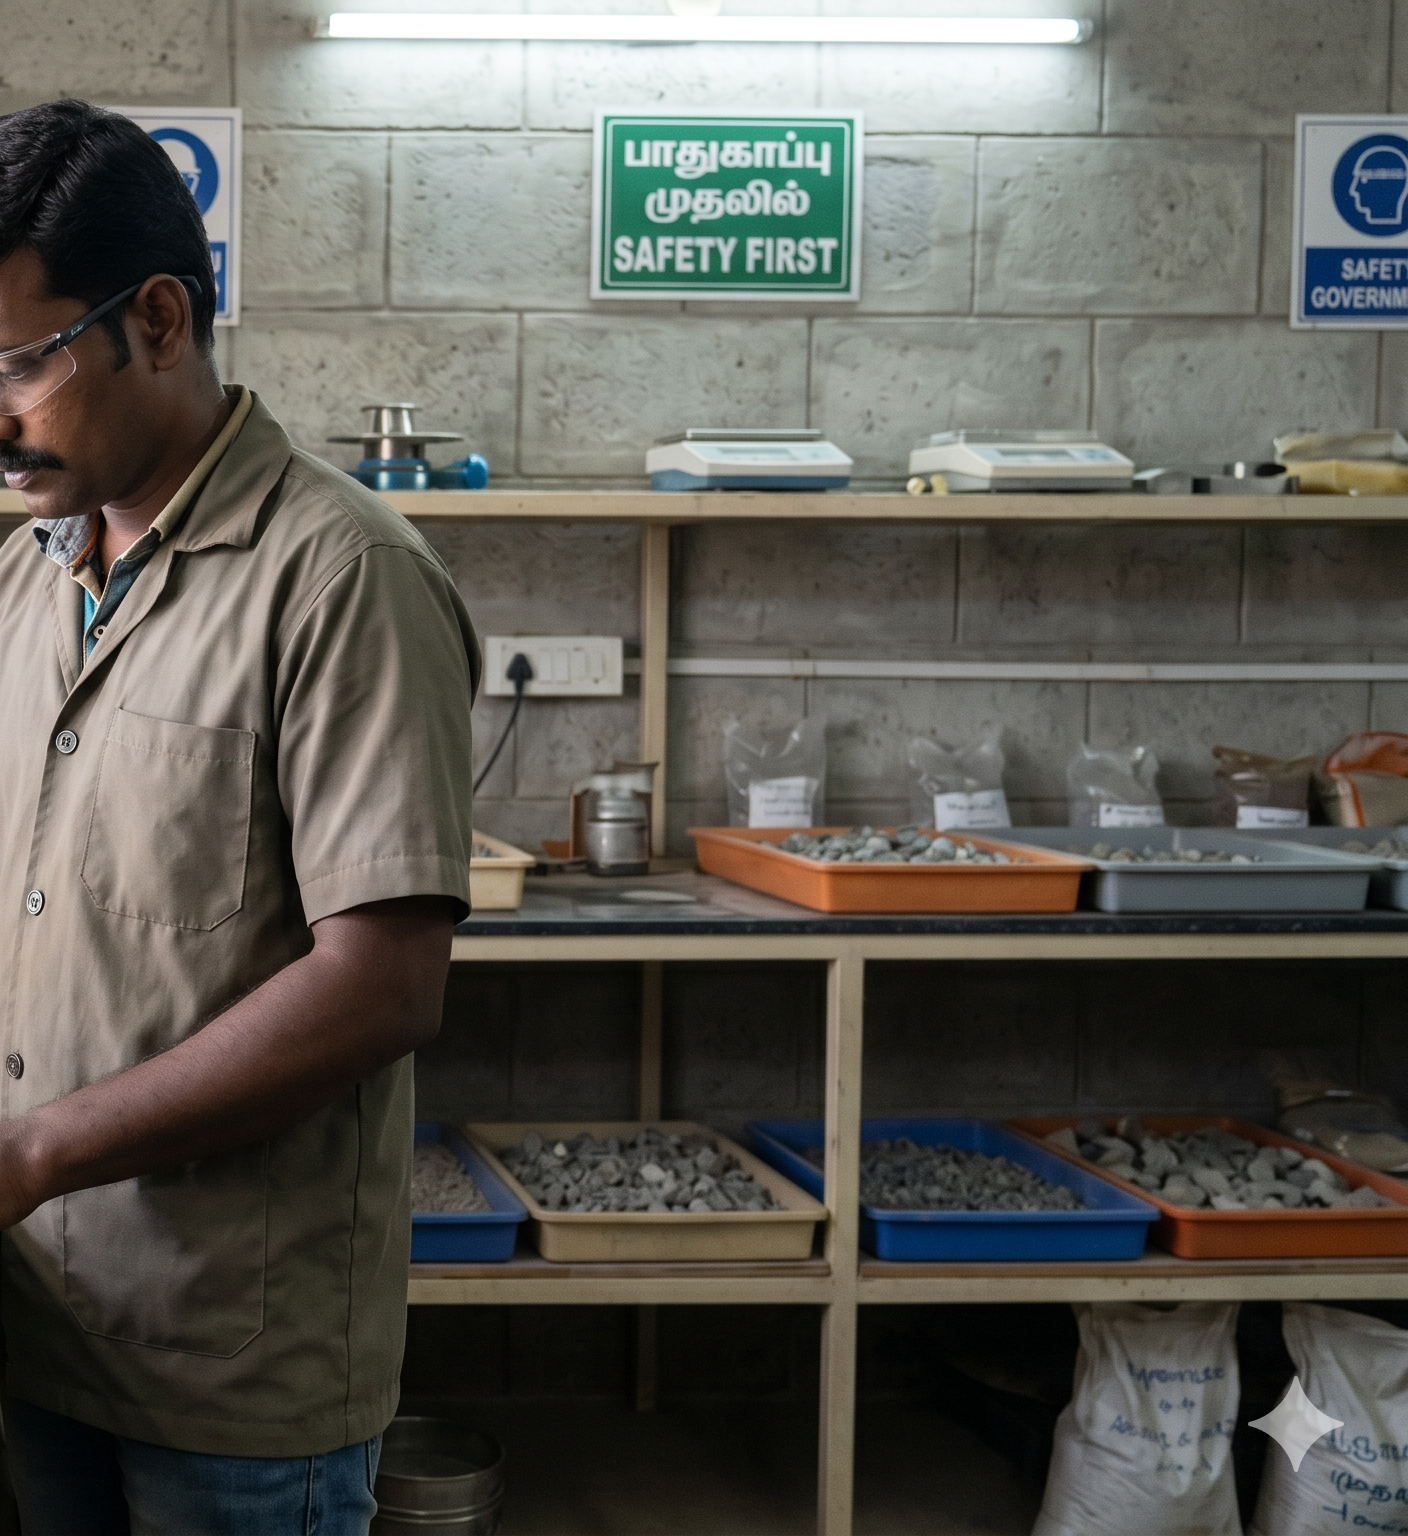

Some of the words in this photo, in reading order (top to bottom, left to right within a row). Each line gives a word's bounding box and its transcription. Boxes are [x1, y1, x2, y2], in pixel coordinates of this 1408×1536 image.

[624, 130, 832, 179] பாதுகாப்பு
[645, 179, 811, 224] முதலில்
[613, 235, 738, 273] SAFETY
[745, 237, 839, 275] FIRST
